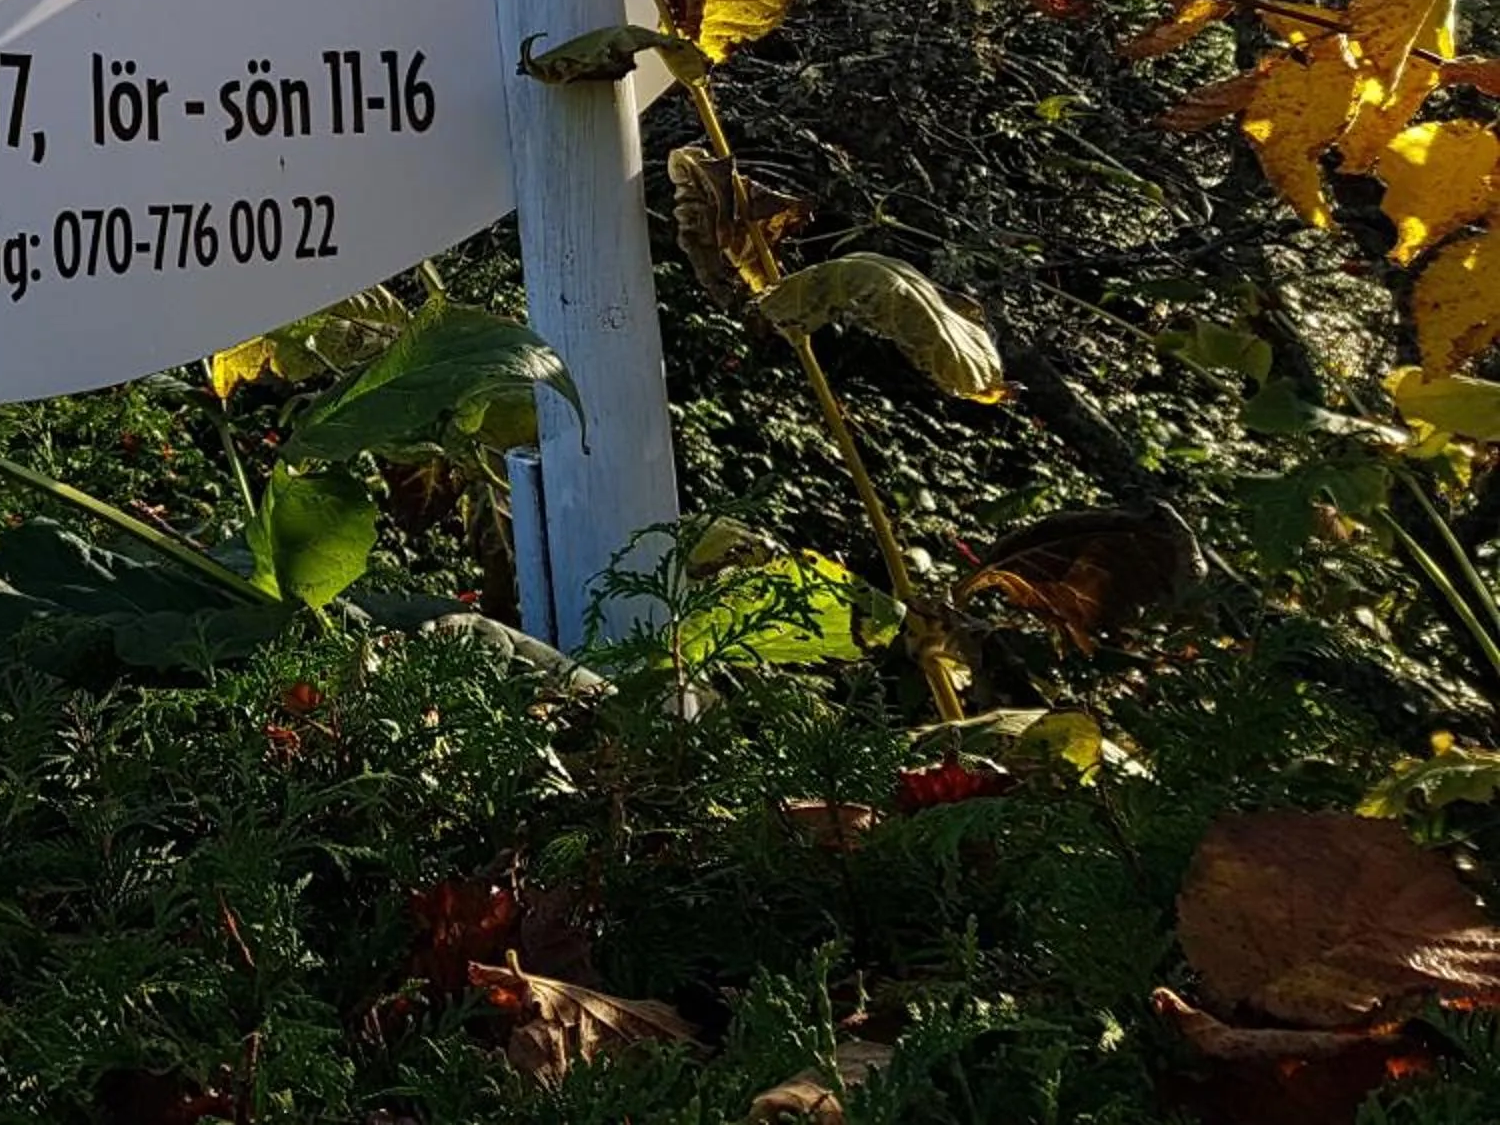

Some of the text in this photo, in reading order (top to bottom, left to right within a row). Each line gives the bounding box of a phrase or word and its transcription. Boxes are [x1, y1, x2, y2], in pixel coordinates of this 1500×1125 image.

[93, 52, 170, 146] lör
[219, 60, 311, 142] sön
[322, 50, 435, 134] 11-16
[53, 202, 219, 280] 070-776
[229, 198, 283, 264] 00
[292, 195, 338, 259] 22
